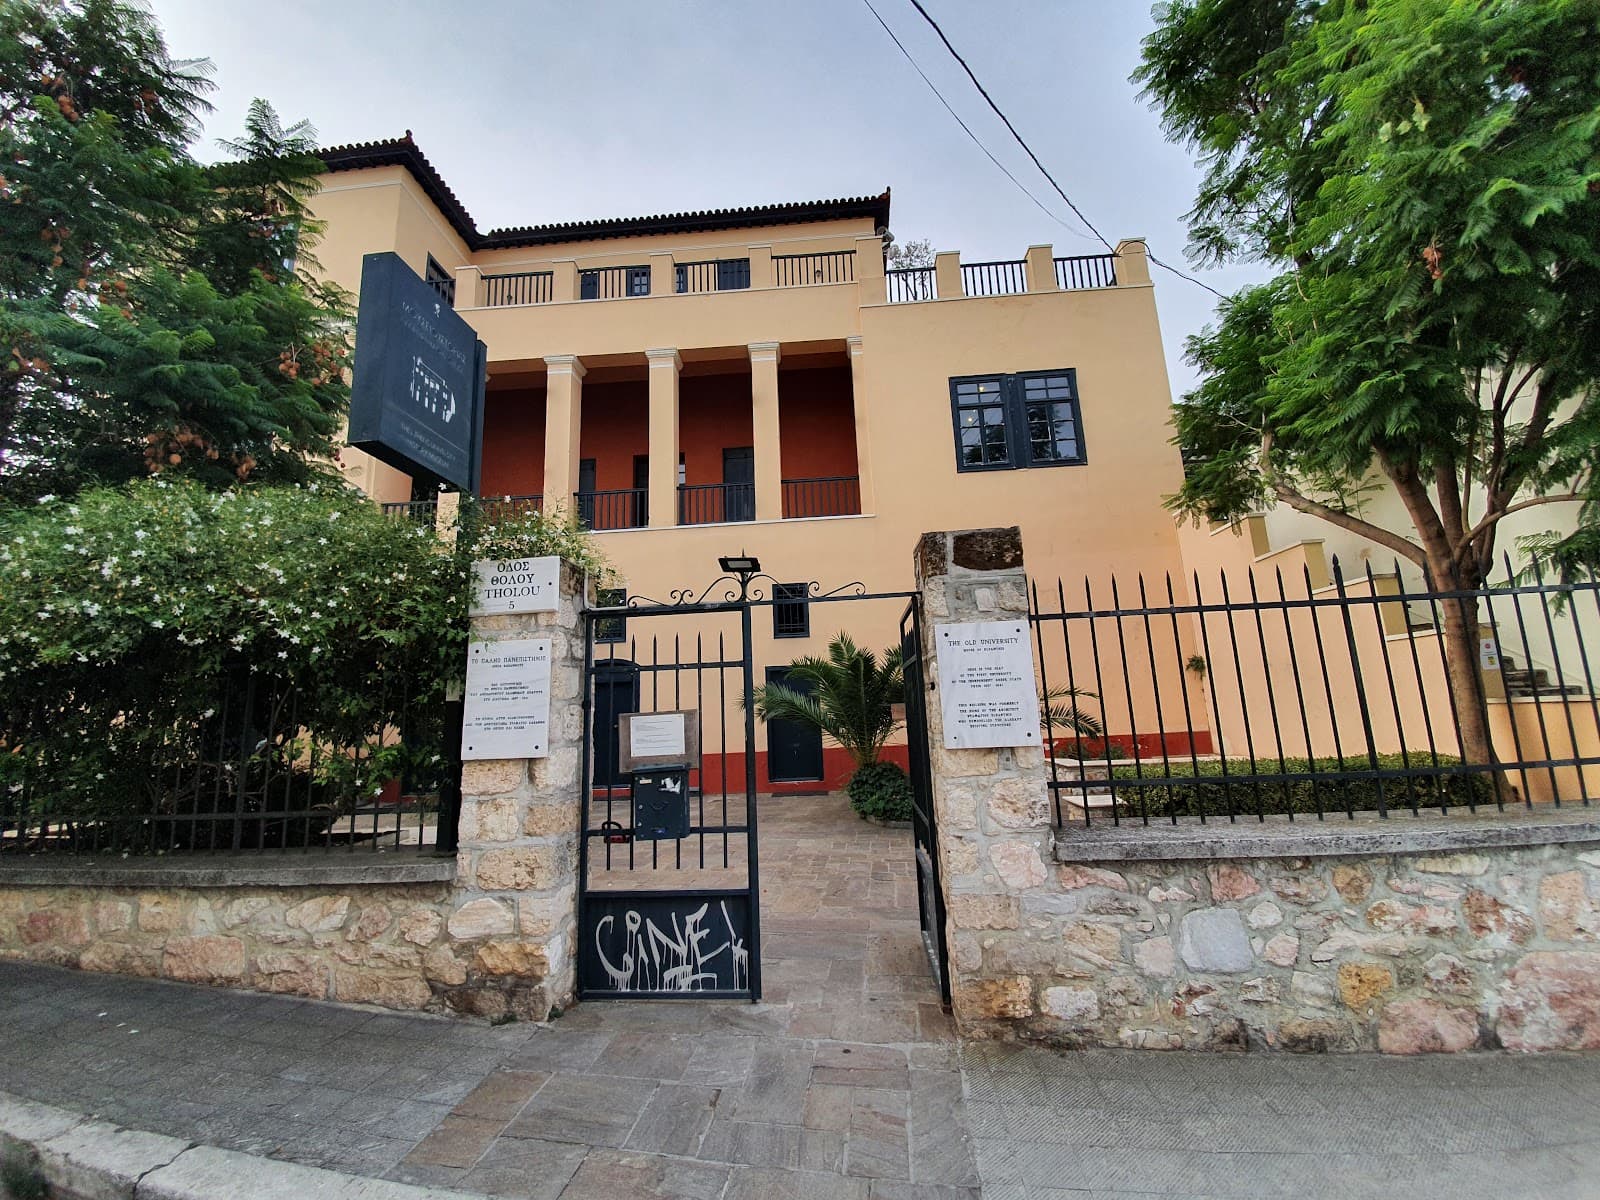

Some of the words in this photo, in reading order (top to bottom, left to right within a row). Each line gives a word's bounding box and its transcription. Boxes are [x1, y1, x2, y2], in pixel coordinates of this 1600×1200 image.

[497, 561, 530, 573] ΟΔΟΣ
[490, 573, 535, 586] ΘΟΛΟΥ
[484, 585, 540, 599] THOLOU
[508, 600, 515, 610] 5
[980, 637, 1018, 645] UNIVERSITY
